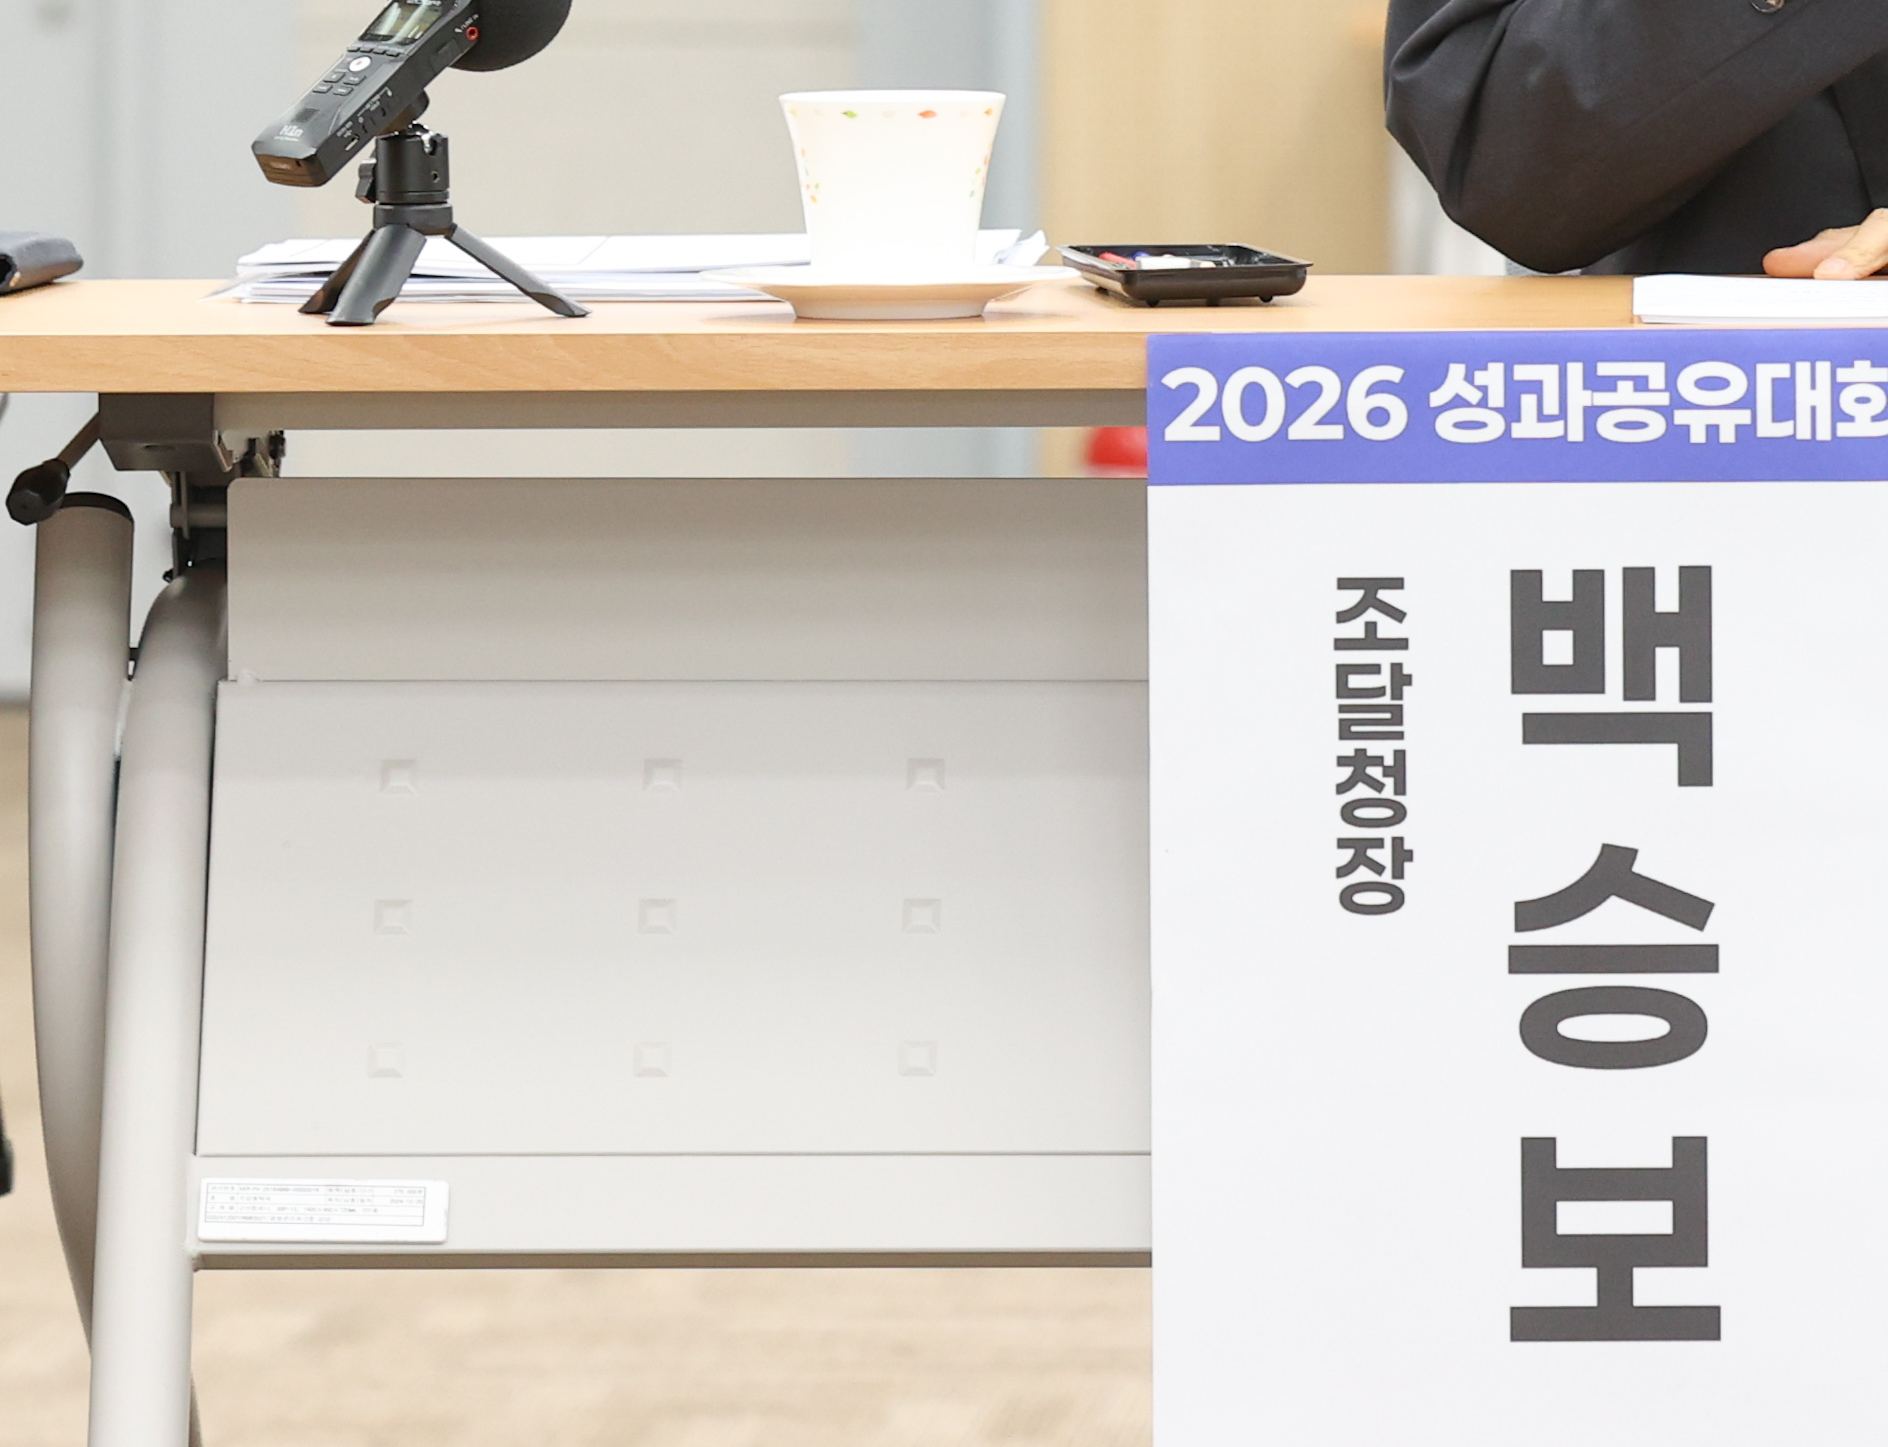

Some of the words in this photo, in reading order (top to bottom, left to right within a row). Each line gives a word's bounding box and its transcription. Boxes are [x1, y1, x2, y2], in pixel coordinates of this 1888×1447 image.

[1161, 364, 1408, 442] 2026
[1333, 577, 1414, 916] 조달청장
[1508, 565, 1722, 1342] 백승보
